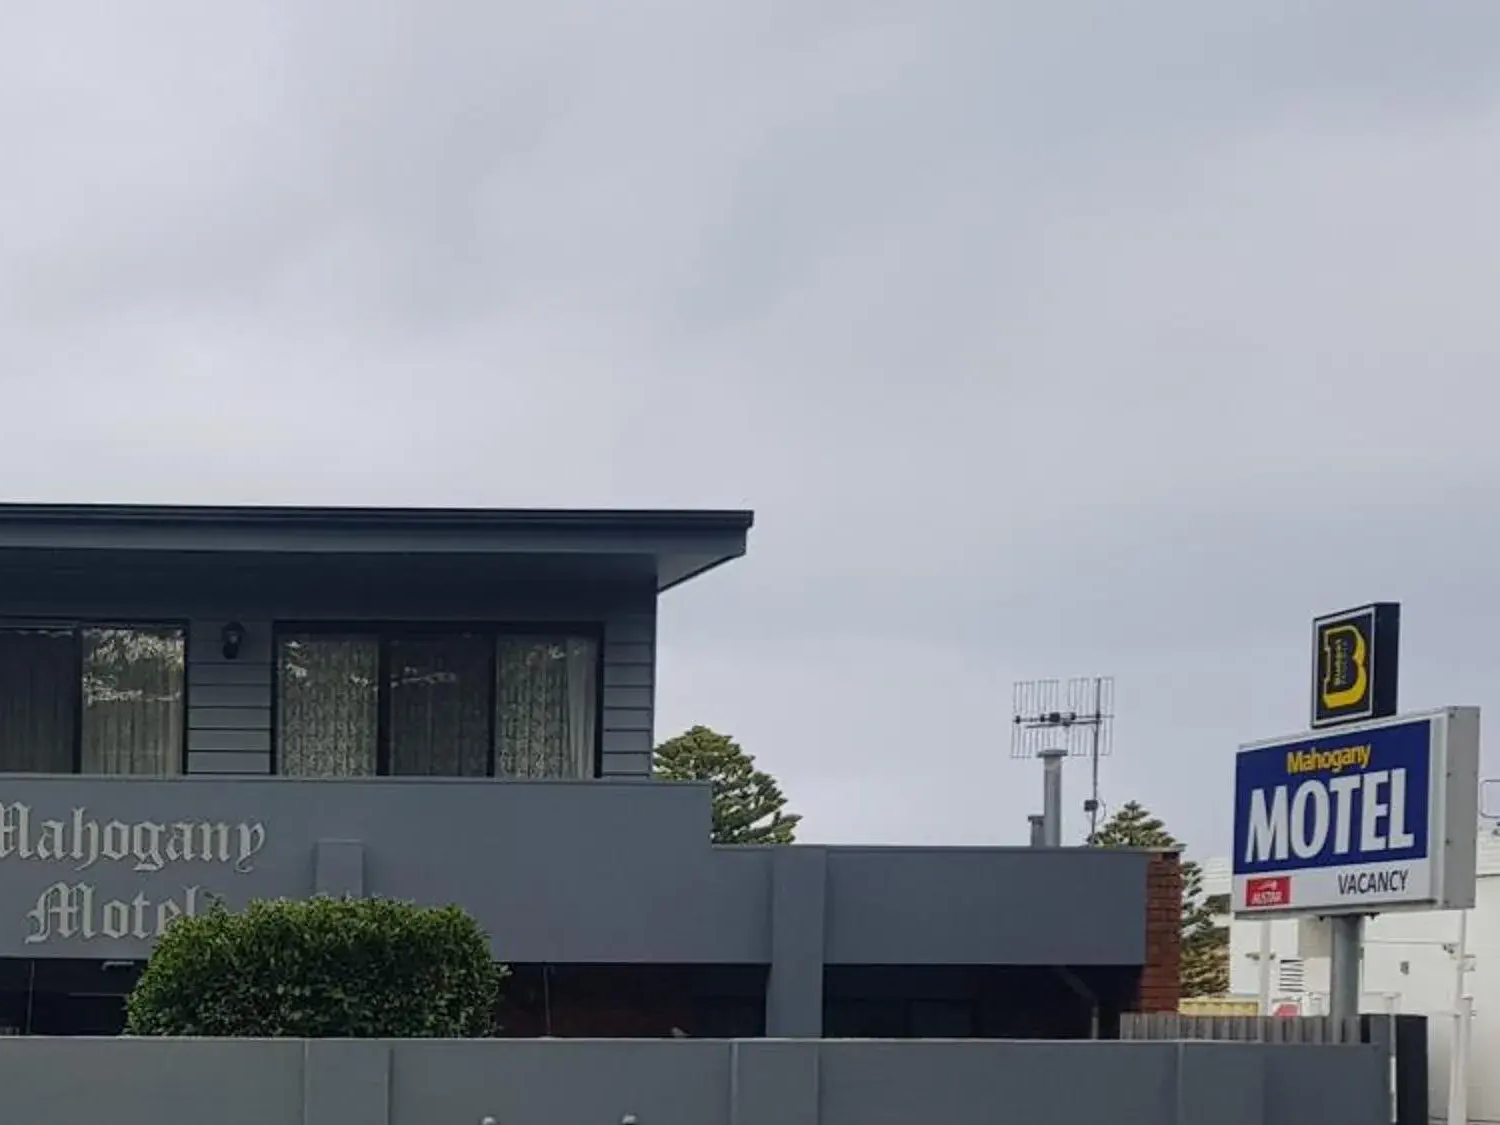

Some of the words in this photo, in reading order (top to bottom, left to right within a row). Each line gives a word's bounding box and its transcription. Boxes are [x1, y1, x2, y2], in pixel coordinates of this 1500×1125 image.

[1286, 743, 1372, 774] Mahogany
[1244, 767, 1415, 863] MOTEL
[1337, 869, 1410, 895] VACANCY
